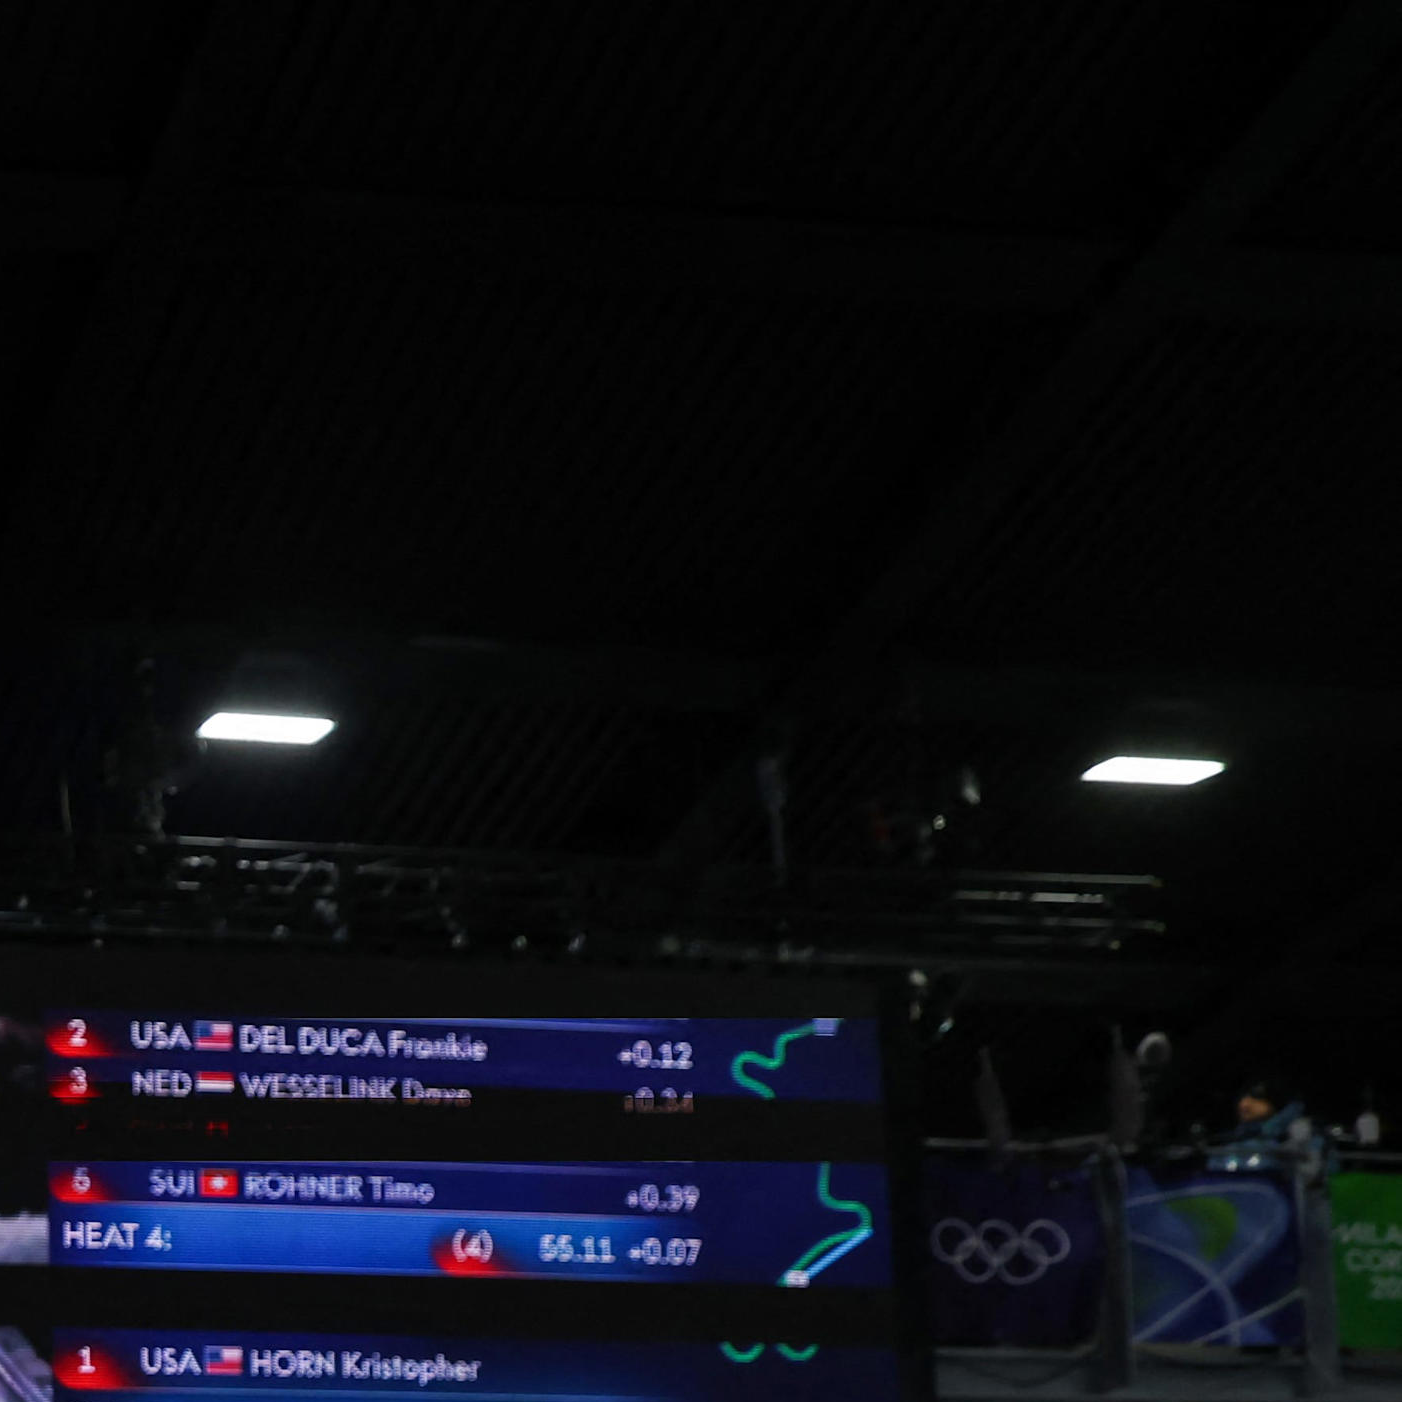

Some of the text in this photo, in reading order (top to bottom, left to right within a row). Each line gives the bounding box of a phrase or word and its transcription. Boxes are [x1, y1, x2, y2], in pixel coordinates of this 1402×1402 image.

[68, 1019, 694, 1070] 2 USA DEL DUCA Frankie +0.12
[69, 1066, 88, 1095] 3
[131, 1069, 192, 1098] NED
[239, 1072, 397, 1101] WESSELINK
[149, 1168, 195, 1197] SUI
[244, 1172, 364, 1201] ROHNER
[367, 1175, 435, 1205] Timo
[625, 1183, 700, 1213] +0.39
[63, 1221, 703, 1266] HEAT 4: (4) 55.11 +0.07
[77, 1346, 482, 1387] 1 USA HORN Kristopher
